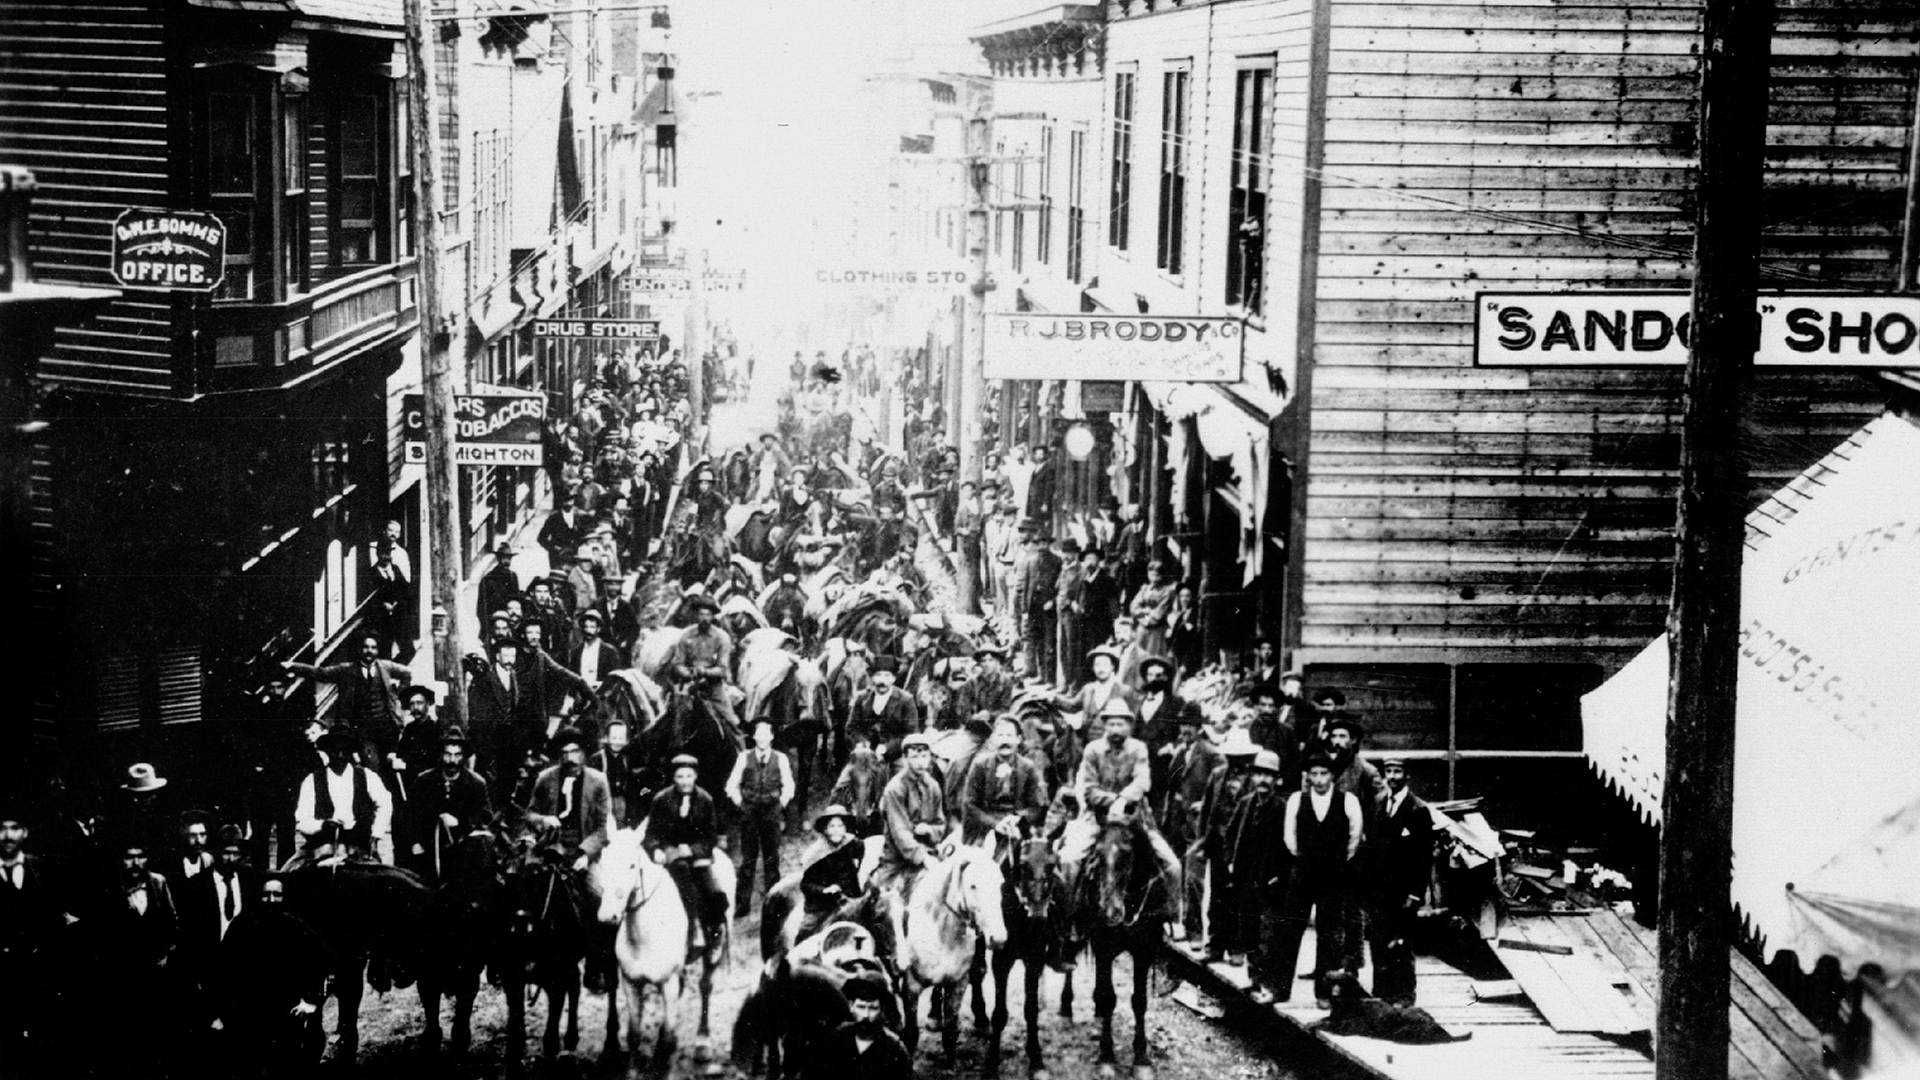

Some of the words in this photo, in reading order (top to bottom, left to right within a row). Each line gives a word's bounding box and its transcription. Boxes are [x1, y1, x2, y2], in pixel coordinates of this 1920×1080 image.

[122, 261, 213, 284] OFFICE.
[816, 270, 917, 283] CLOTHING
[535, 322, 586, 336] DRUG
[1785, 307, 1920, 355] SHO
